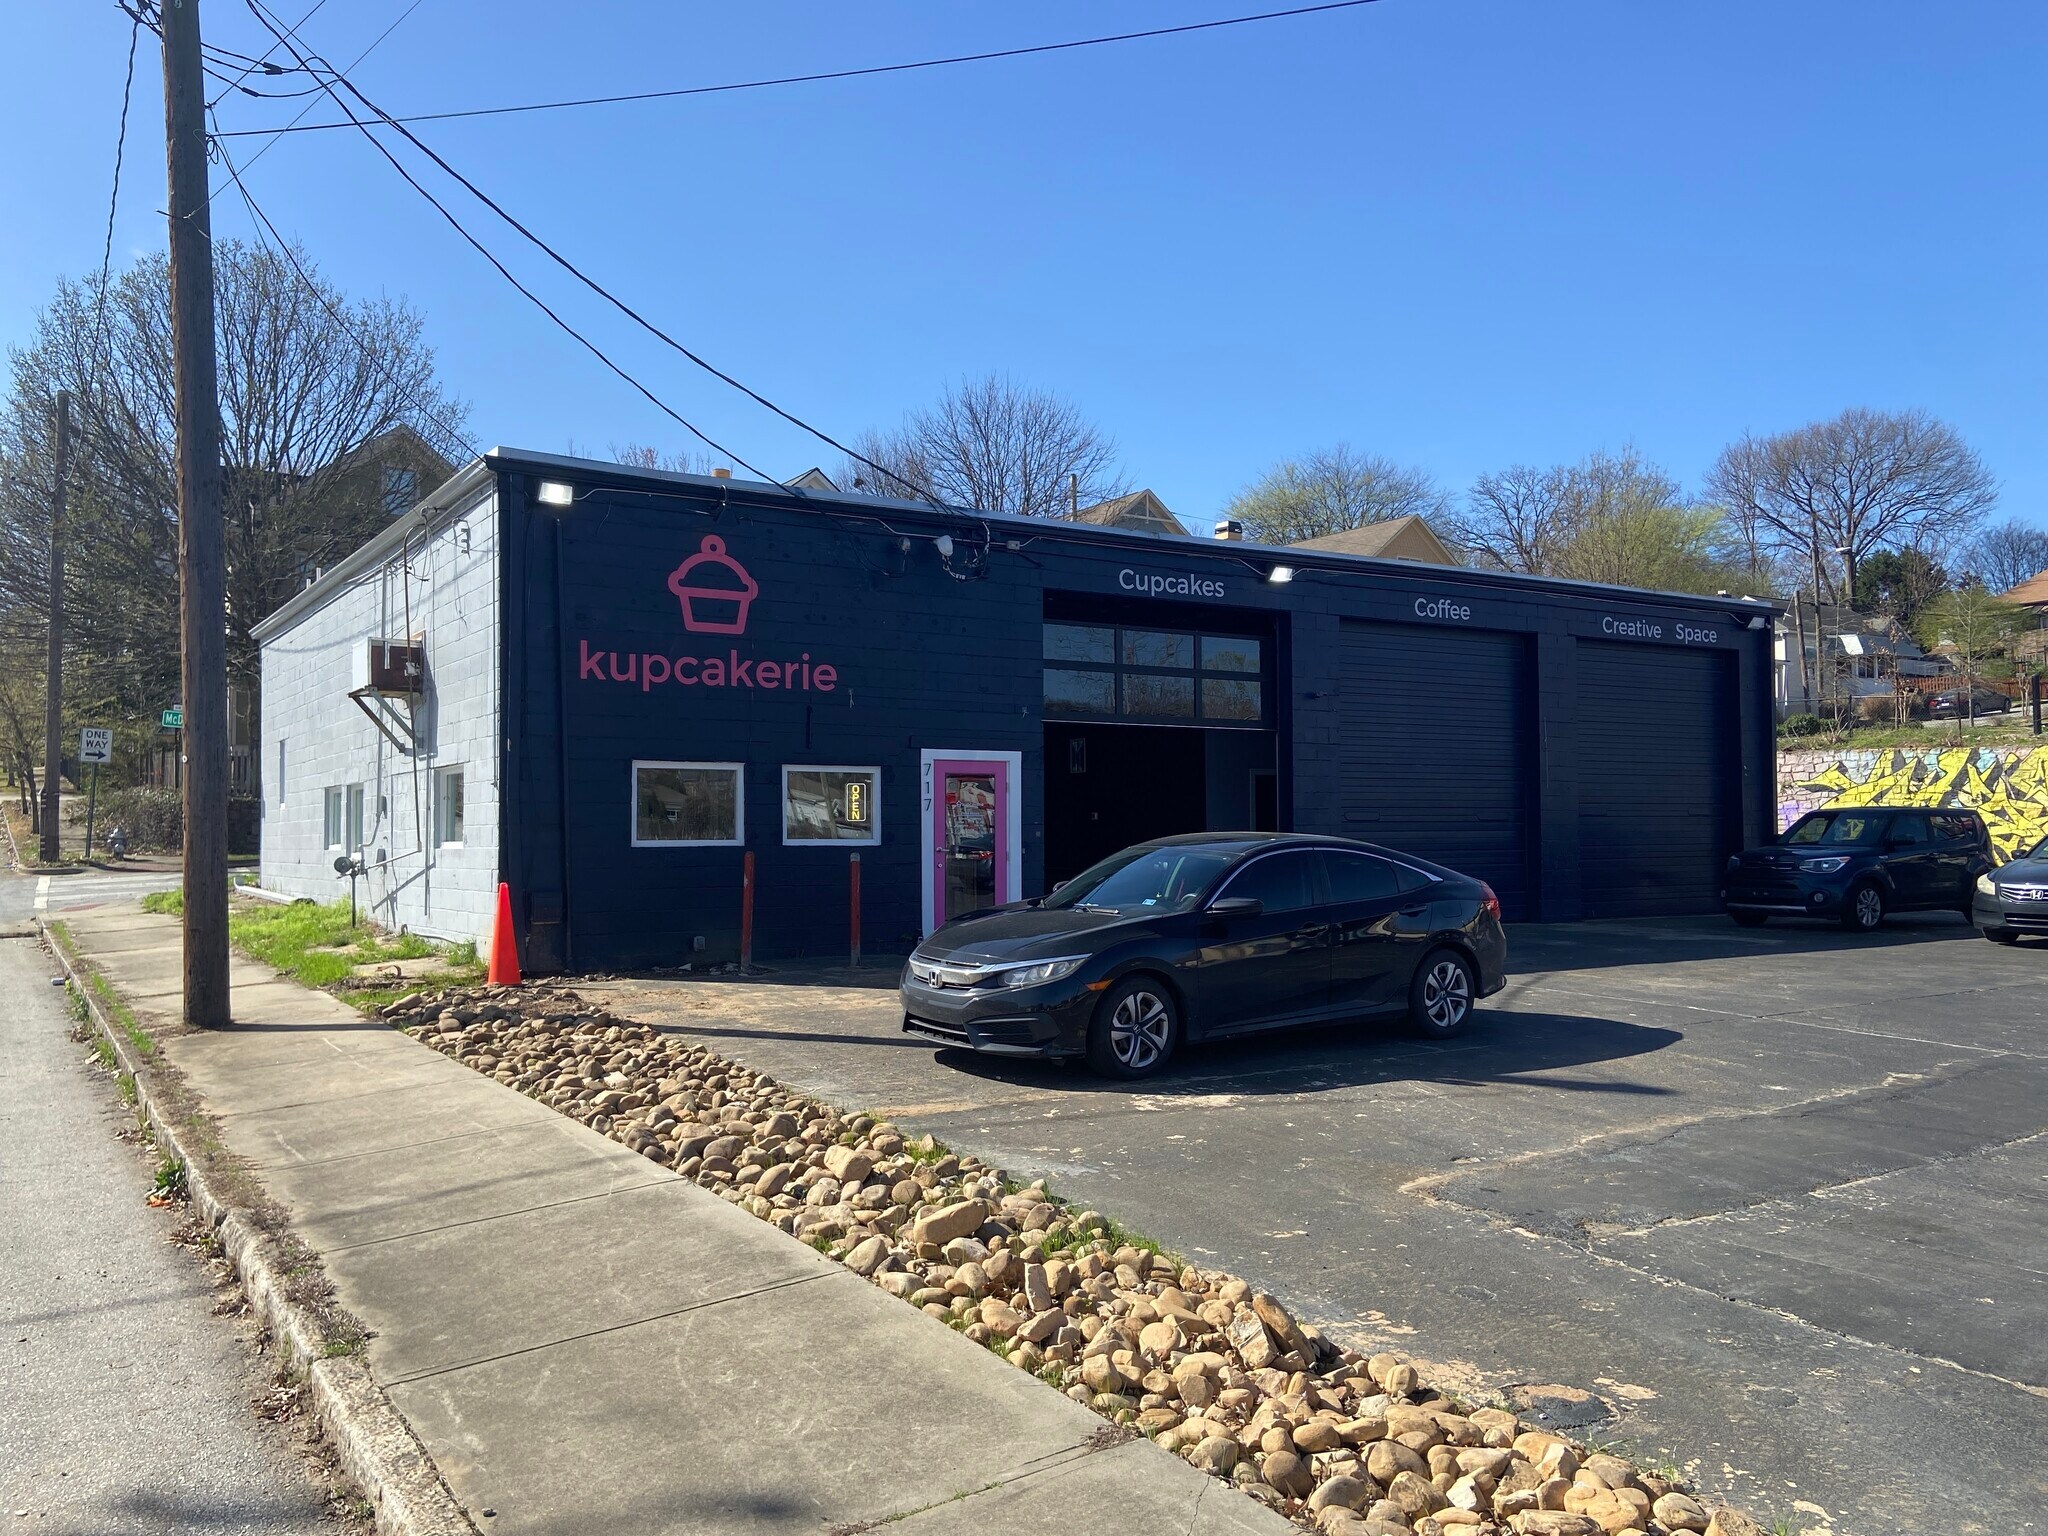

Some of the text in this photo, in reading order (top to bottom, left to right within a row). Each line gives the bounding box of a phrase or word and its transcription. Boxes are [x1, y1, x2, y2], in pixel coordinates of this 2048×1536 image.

[1119, 568, 1225, 598] Cupcakes
[1414, 597, 1470, 621] Coffee
[1602, 617, 1717, 645] Creative Space
[580, 640, 838, 692] kupcakerie
[86, 730, 109, 740] ONE
[86, 740, 109, 750] WAY
[851, 785, 860, 820] OPEN
